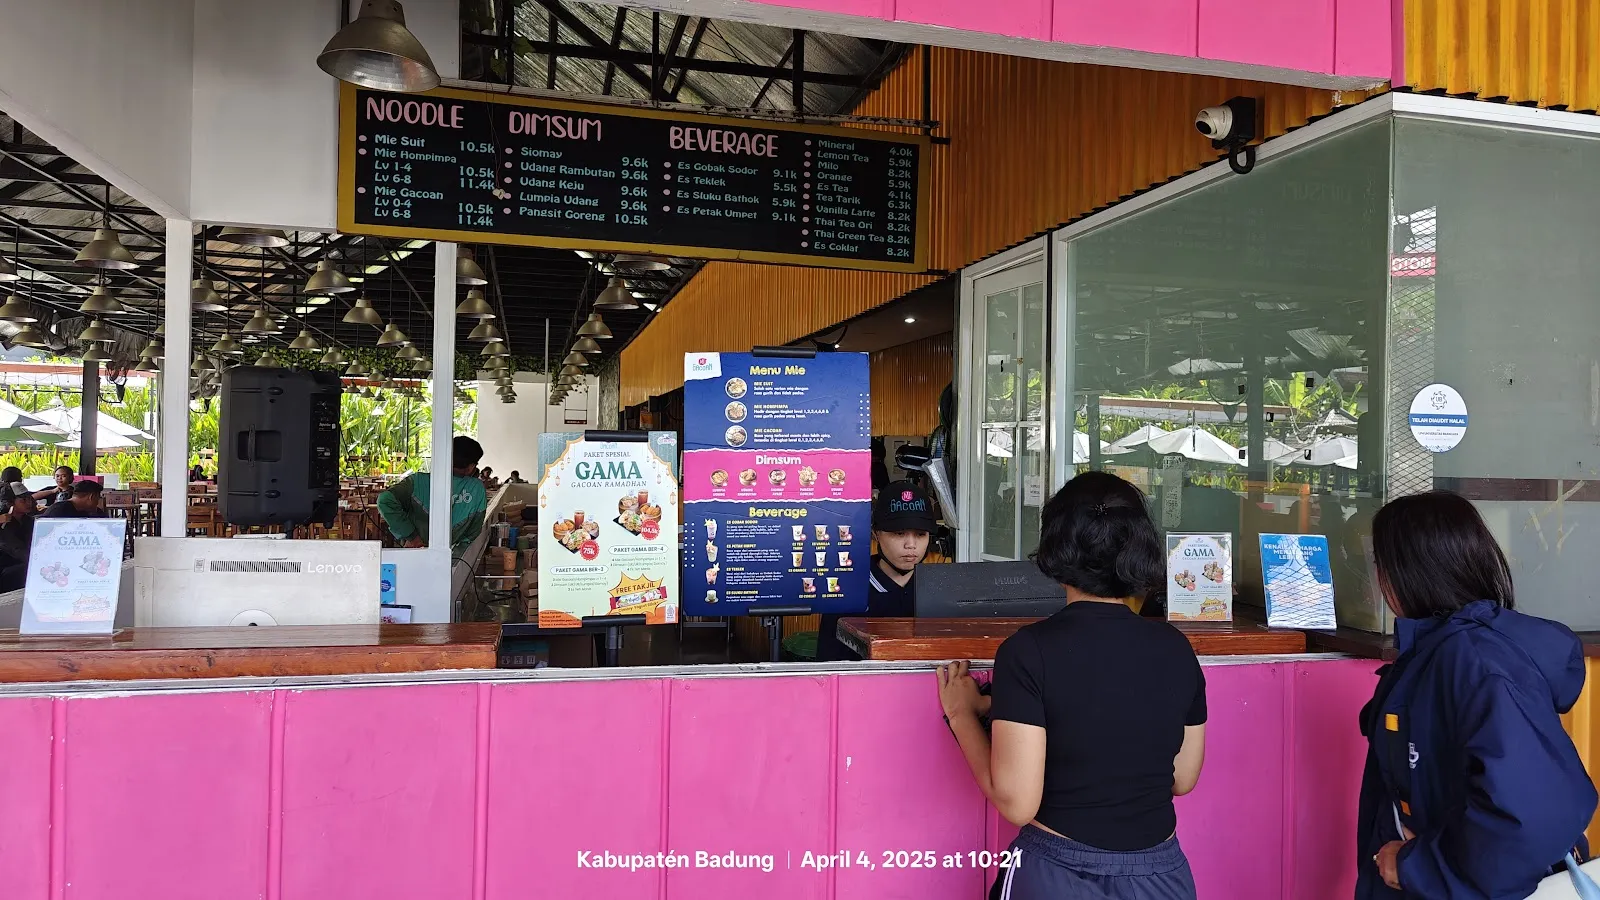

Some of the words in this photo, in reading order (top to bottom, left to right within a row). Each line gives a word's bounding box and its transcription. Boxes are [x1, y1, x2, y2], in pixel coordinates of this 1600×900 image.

[366, 97, 464, 129] NOODLE
[509, 111, 601, 141] DIMSUM
[375, 134, 397, 145] Mie
[400, 137, 425, 148] Suit
[460, 141, 495, 154] 10.5k
[670, 125, 778, 157] BEVERAGE
[818, 140, 855, 150] Mineral
[890, 147, 912, 157] 4.0k
[374, 149, 396, 158] Mie
[400, 150, 457, 163] Hompimpa
[521, 147, 563, 160] Siomay
[622, 157, 648, 168] 9.6k
[818, 150, 849, 160] Lemon
[853, 153, 869, 162] Tea
[889, 158, 911, 168] 5.9k
[375, 161, 389, 170] Lv
[393, 162, 412, 172] 1-4
[460, 166, 494, 178] 10.5k
[521, 162, 555, 174] Udang
[559, 165, 615, 178] Rambutan
[621, 170, 648, 180] 9.6k
[678, 161, 691, 170] Es
[694, 162, 725, 173] Gobak
[728, 165, 758, 175] Sodor
[773, 169, 797, 179] 9.1k
[818, 162, 839, 170] Milo
[889, 169, 911, 178] 8.2k
[375, 173, 389, 182] Lv
[392, 174, 411, 184] 6-8
[460, 179, 495, 190] 11.4k
[520, 177, 555, 189] Udang
[559, 180, 584, 191] Keju
[621, 186, 647, 197] 9.6k
[678, 175, 690, 184] Es
[693, 176, 725, 186] Teklek
[773, 183, 797, 193] 5.5k
[818, 172, 852, 183] Orange
[888, 180, 911, 189] 5.9k
[375, 187, 396, 197] Mie
[400, 189, 443, 200] Gacoan
[677, 190, 689, 198] Es
[693, 191, 721, 201] Sluku
[725, 193, 759, 204] Bathok
[772, 197, 796, 208] 5.9k
[817, 183, 830, 191] Es
[833, 183, 849, 192] Tea
[888, 191, 911, 200] 4.1k
[375, 198, 389, 207] Lv
[392, 198, 412, 208] 0-4
[458, 203, 493, 215] 10.5k
[520, 192, 560, 204] Lumpia
[563, 195, 599, 207] Udang
[621, 200, 647, 211] 9.6k
[816, 193, 833, 202] Tea
[835, 195, 860, 204] Tarik
[888, 200, 910, 210] 6.3k
[375, 208, 389, 217] Lv
[392, 209, 411, 218] 6-8
[458, 215, 493, 226] 11.4k
[519, 207, 562, 219] Pangsit
[565, 210, 605, 222] Goreng
[615, 214, 648, 225] 10.5k
[677, 206, 689, 214] Es
[693, 207, 722, 217] Petak
[725, 209, 757, 219] Umpet
[772, 212, 796, 222] 9.1k
[816, 206, 849, 215] Vanilla
[851, 208, 875, 217] Latte
[888, 211, 910, 221] 8.2k
[815, 217, 837, 226] Thai
[839, 219, 856, 228] Tea
[858, 220, 873, 229] Ori
[887, 222, 910, 232] 8.2k
[814, 229, 835, 239] Thai
[838, 231, 866, 241] Green
[868, 233, 884, 242] Tea
[887, 234, 909, 244] 8.2k
[814, 241, 826, 249] Es
[829, 242, 858, 252] Coklat
[887, 247, 909, 257] 8.2k
[750, 365, 781, 375] Menu
[785, 365, 805, 375] Mie
[756, 455, 801, 464] Dimsum
[576, 461, 642, 480] GAMA
[749, 507, 807, 519] Beverage
[890, 498, 927, 513] GACOAN
[58, 536, 100, 545] GAMA
[307, 562, 362, 573] Lenovo
[616, 586, 631, 594] FREE
